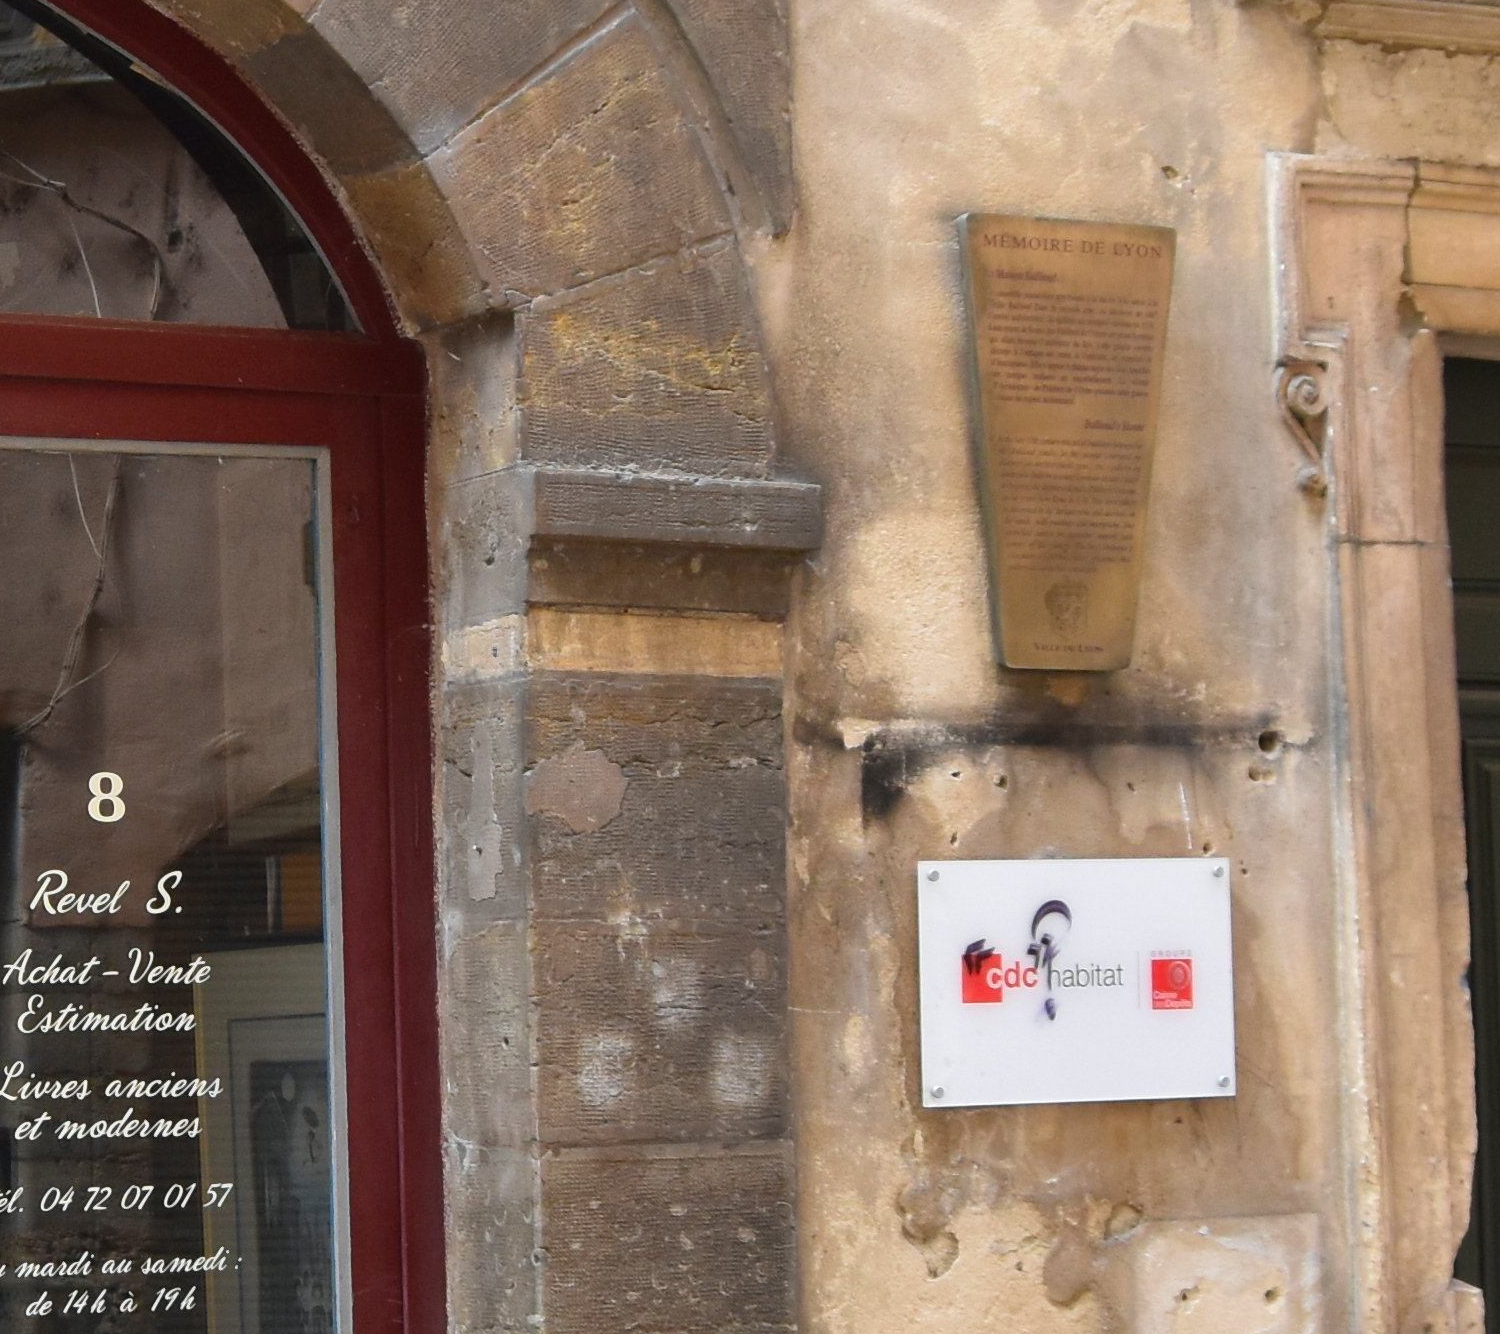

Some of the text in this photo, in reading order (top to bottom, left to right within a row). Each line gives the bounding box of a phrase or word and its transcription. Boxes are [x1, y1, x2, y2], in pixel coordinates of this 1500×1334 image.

[1080, 239, 1163, 260] DE LYON
[87, 771, 127, 823] 8
[29, 869, 184, 916] Revel S.
[3, 947, 211, 985] Achat Vente
[986, 961, 1125, 989] cdc habitat
[16, 994, 197, 1033] Estimation
[105, 1071, 223, 1100] anciens
[14, 1108, 202, 1142] et modernes
[40, 1186, 74, 1213] 04
[83, 1186, 113, 1212] 72
[120, 1185, 152, 1212] 07
[163, 1184, 195, 1211] 01
[203, 1182, 233, 1208] 57
[17, 1252, 91, 1278] mardi
[102, 1257, 132, 1276] au
[142, 1247, 227, 1275] samedi
[25, 1293, 53, 1317] de
[120, 1293, 138, 1313] à
